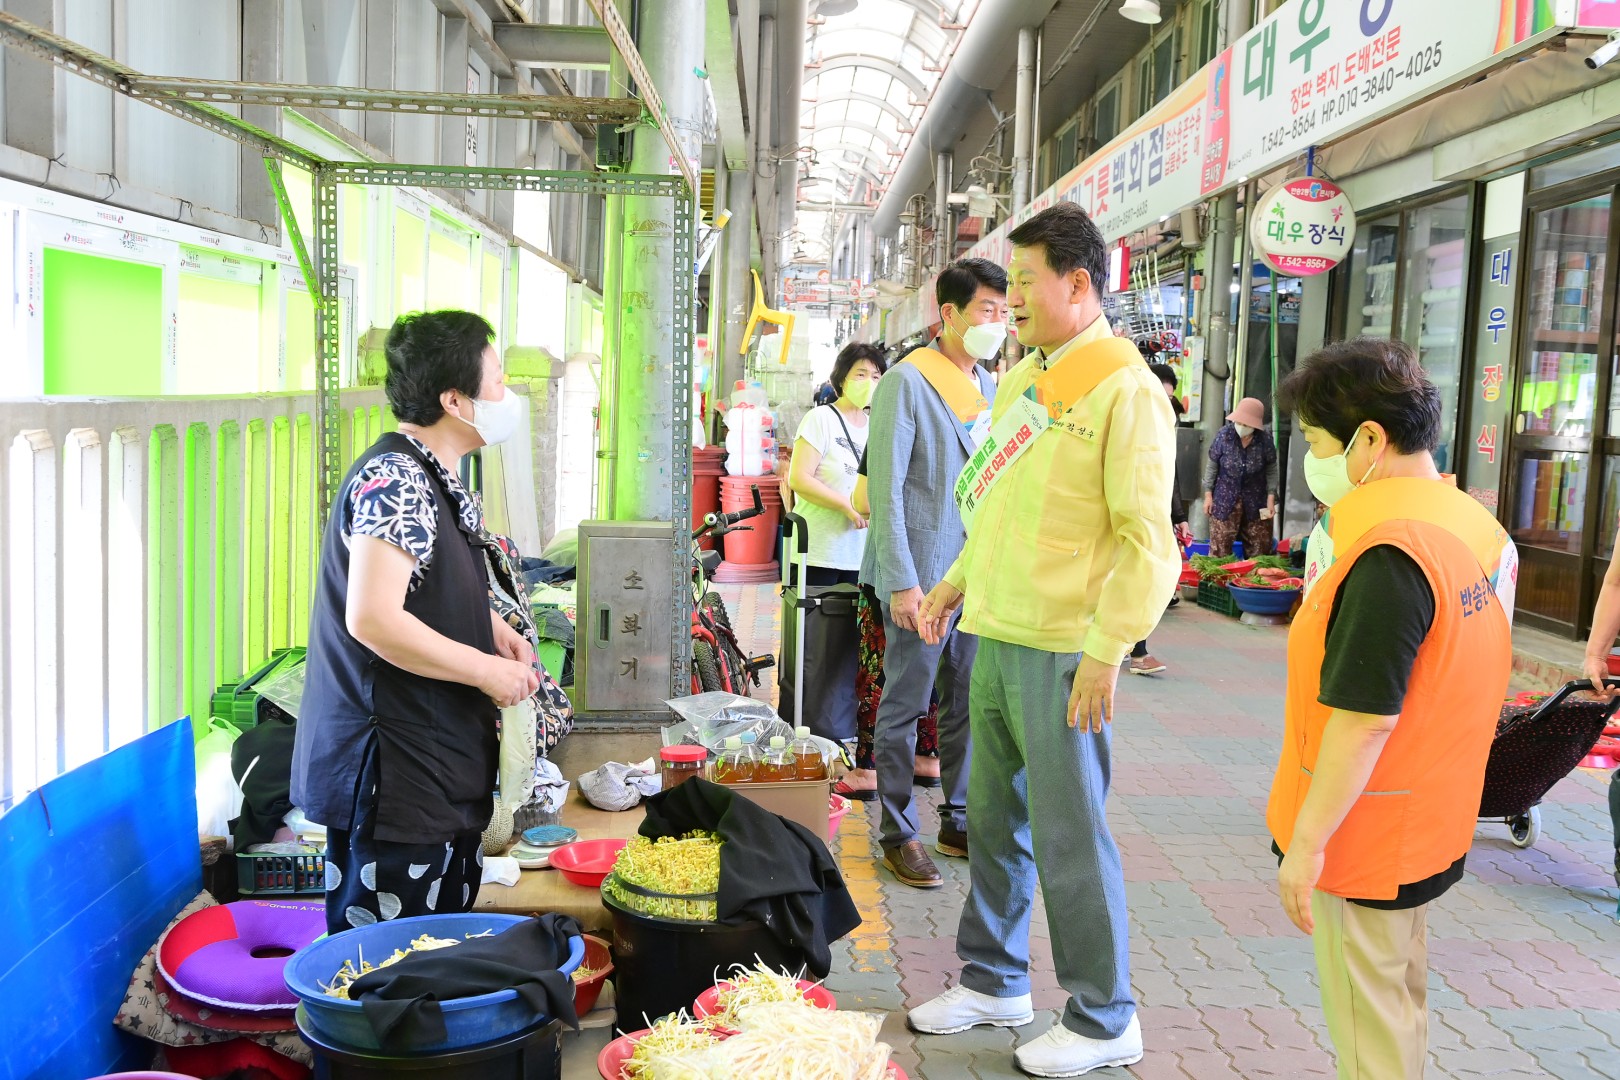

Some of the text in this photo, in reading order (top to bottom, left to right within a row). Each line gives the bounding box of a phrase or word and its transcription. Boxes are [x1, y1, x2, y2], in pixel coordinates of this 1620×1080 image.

[1290, 25, 1401, 115] 장판 벽지 도배전문
[1261, 109, 1316, 155] T.542-8564
[1278, 256, 1327, 269] T.542-8564
